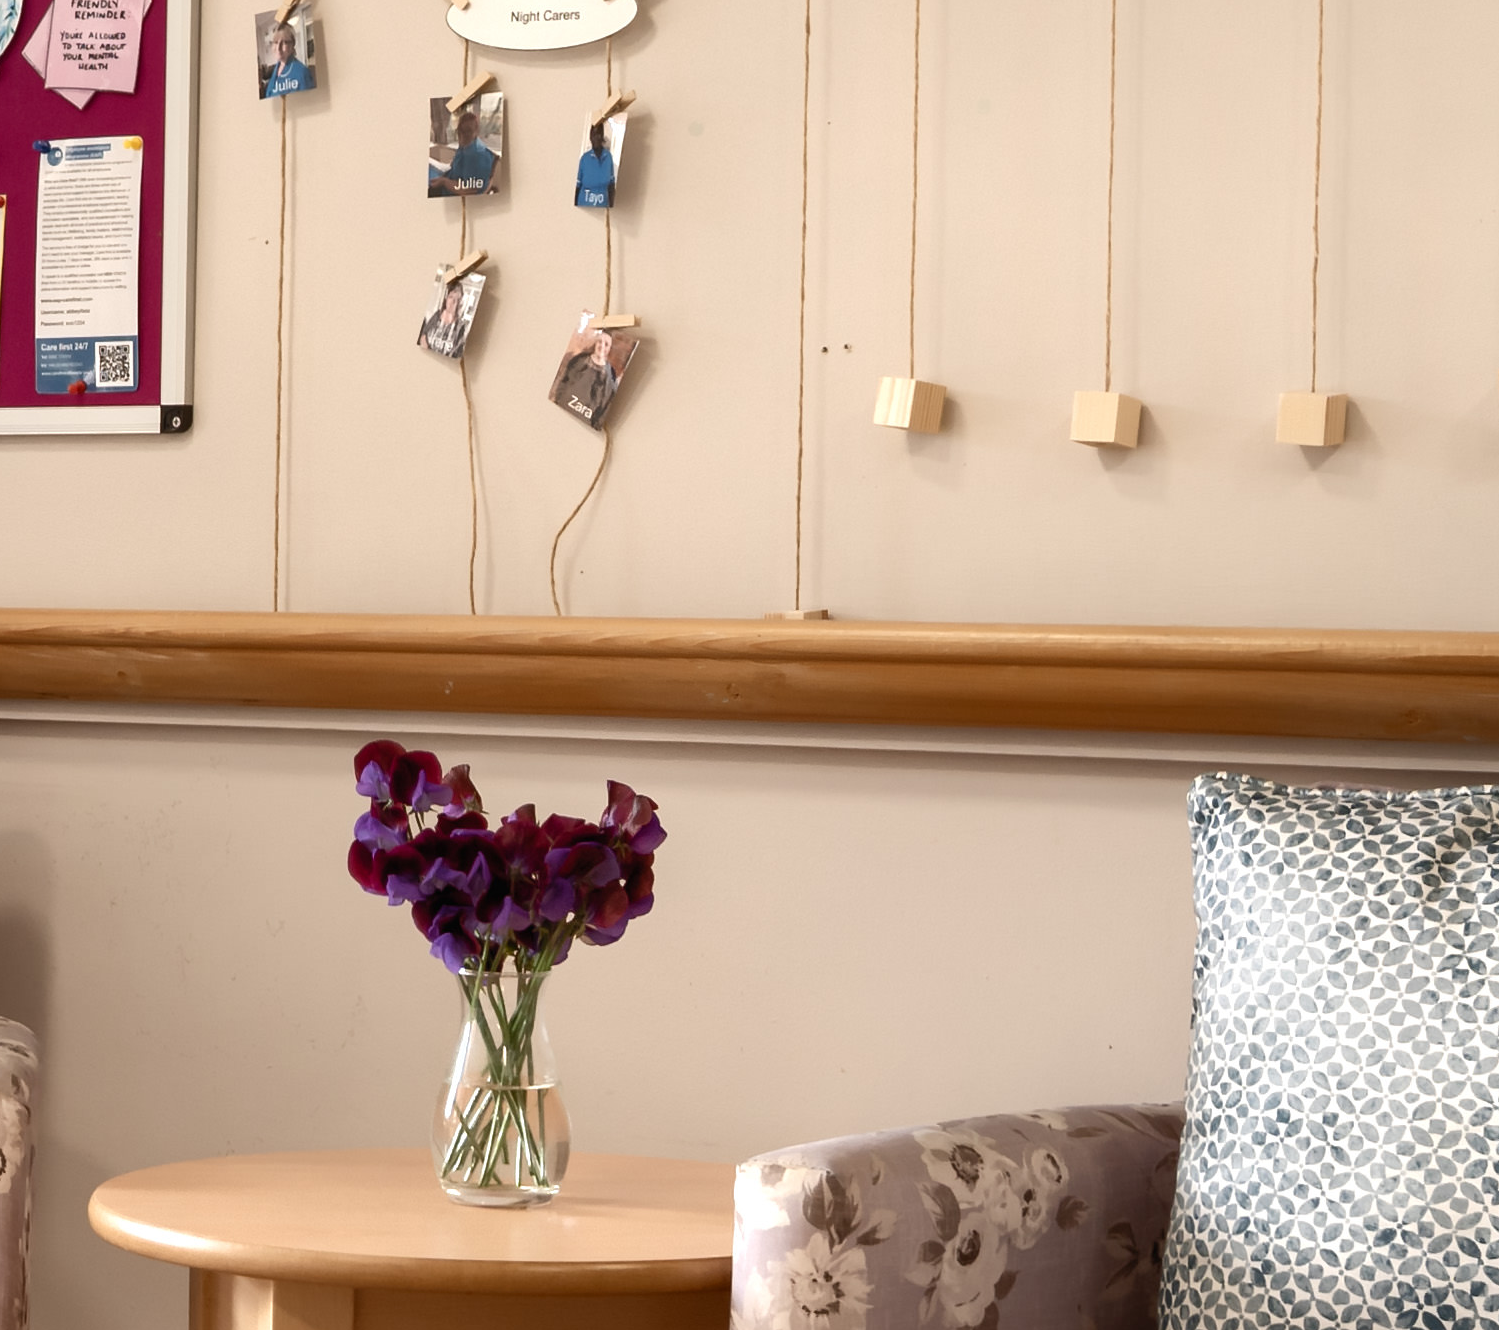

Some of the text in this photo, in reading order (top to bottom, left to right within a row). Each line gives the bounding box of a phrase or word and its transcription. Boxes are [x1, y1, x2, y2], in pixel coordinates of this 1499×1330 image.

[71, 0, 119, 9] FRIENDLY
[511, 9, 581, 24] Night Carers
[272, 79, 299, 93] Julie
[454, 177, 484, 191] Julie
[584, 190, 604, 205] Tayo
[567, 395, 593, 419] Zara
